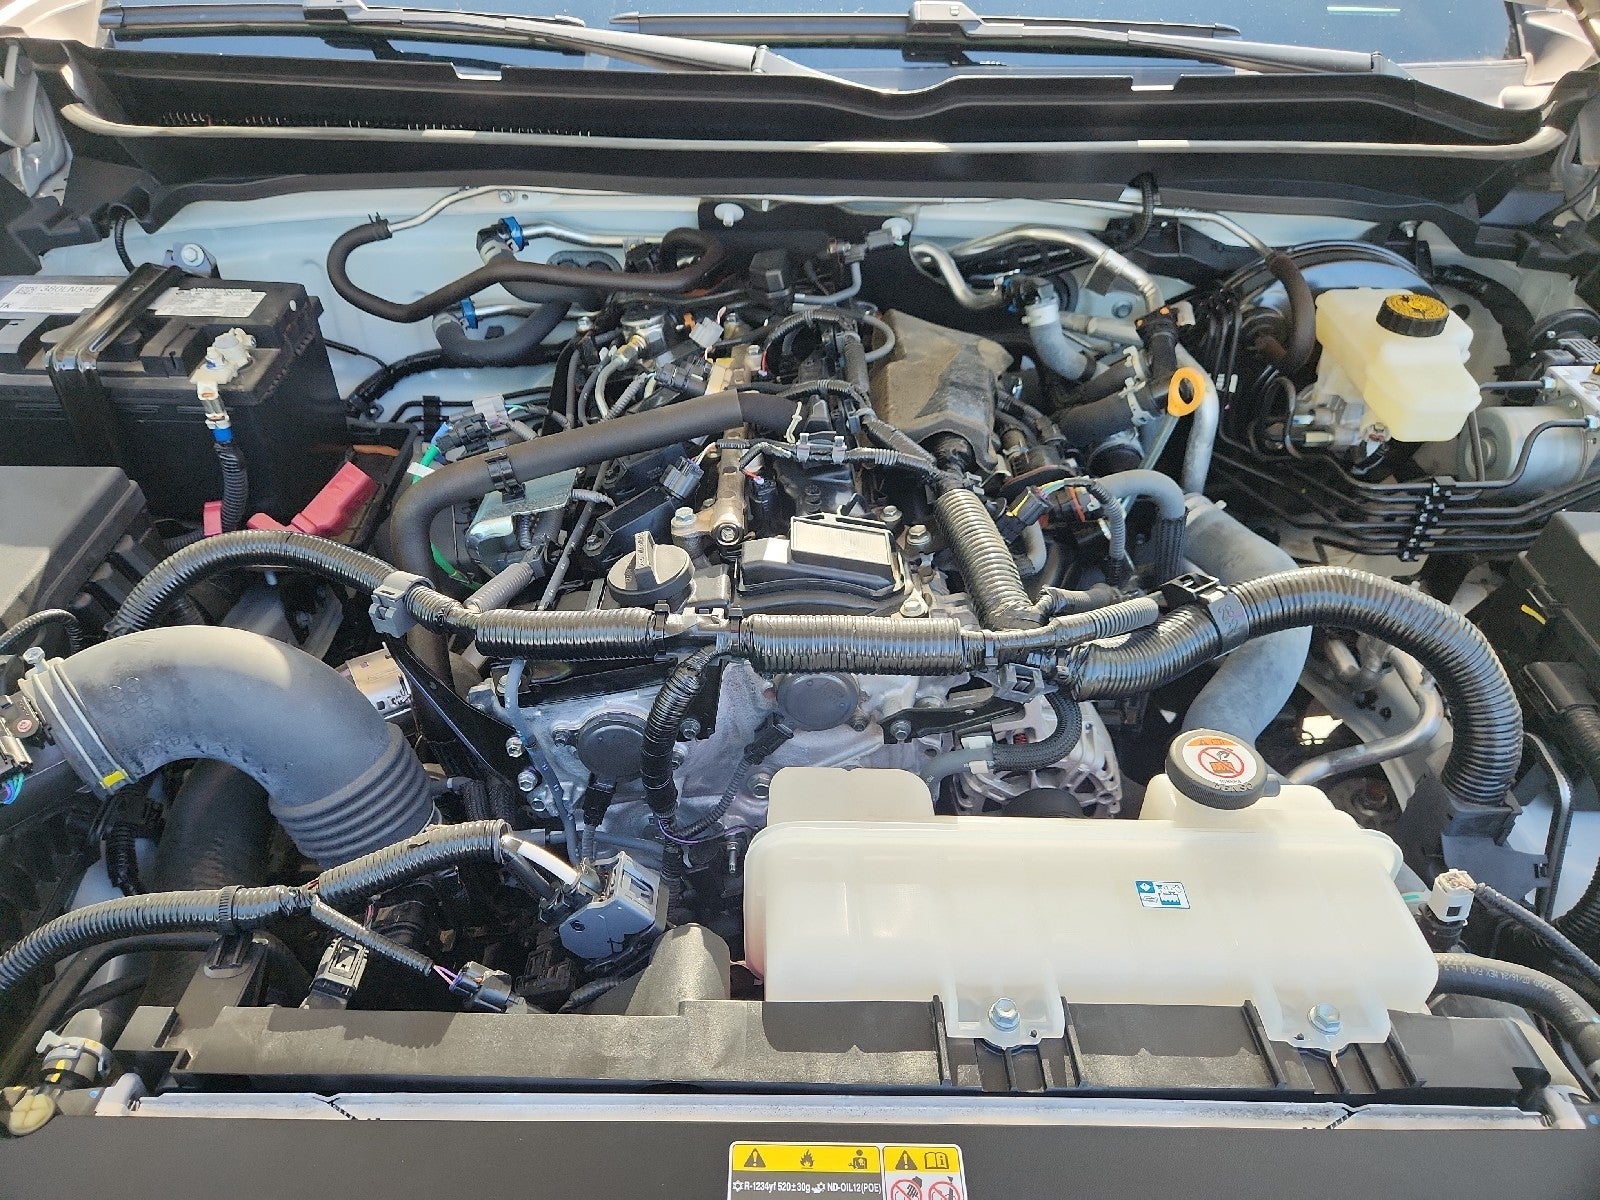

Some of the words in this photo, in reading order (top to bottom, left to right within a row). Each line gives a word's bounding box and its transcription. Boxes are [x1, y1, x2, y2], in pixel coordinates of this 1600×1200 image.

[744, 1181, 776, 1193] R-1234yf
[777, 1181, 811, 1194] 520±30g
[827, 1182, 881, 1194] ND-OIL12(POE)
